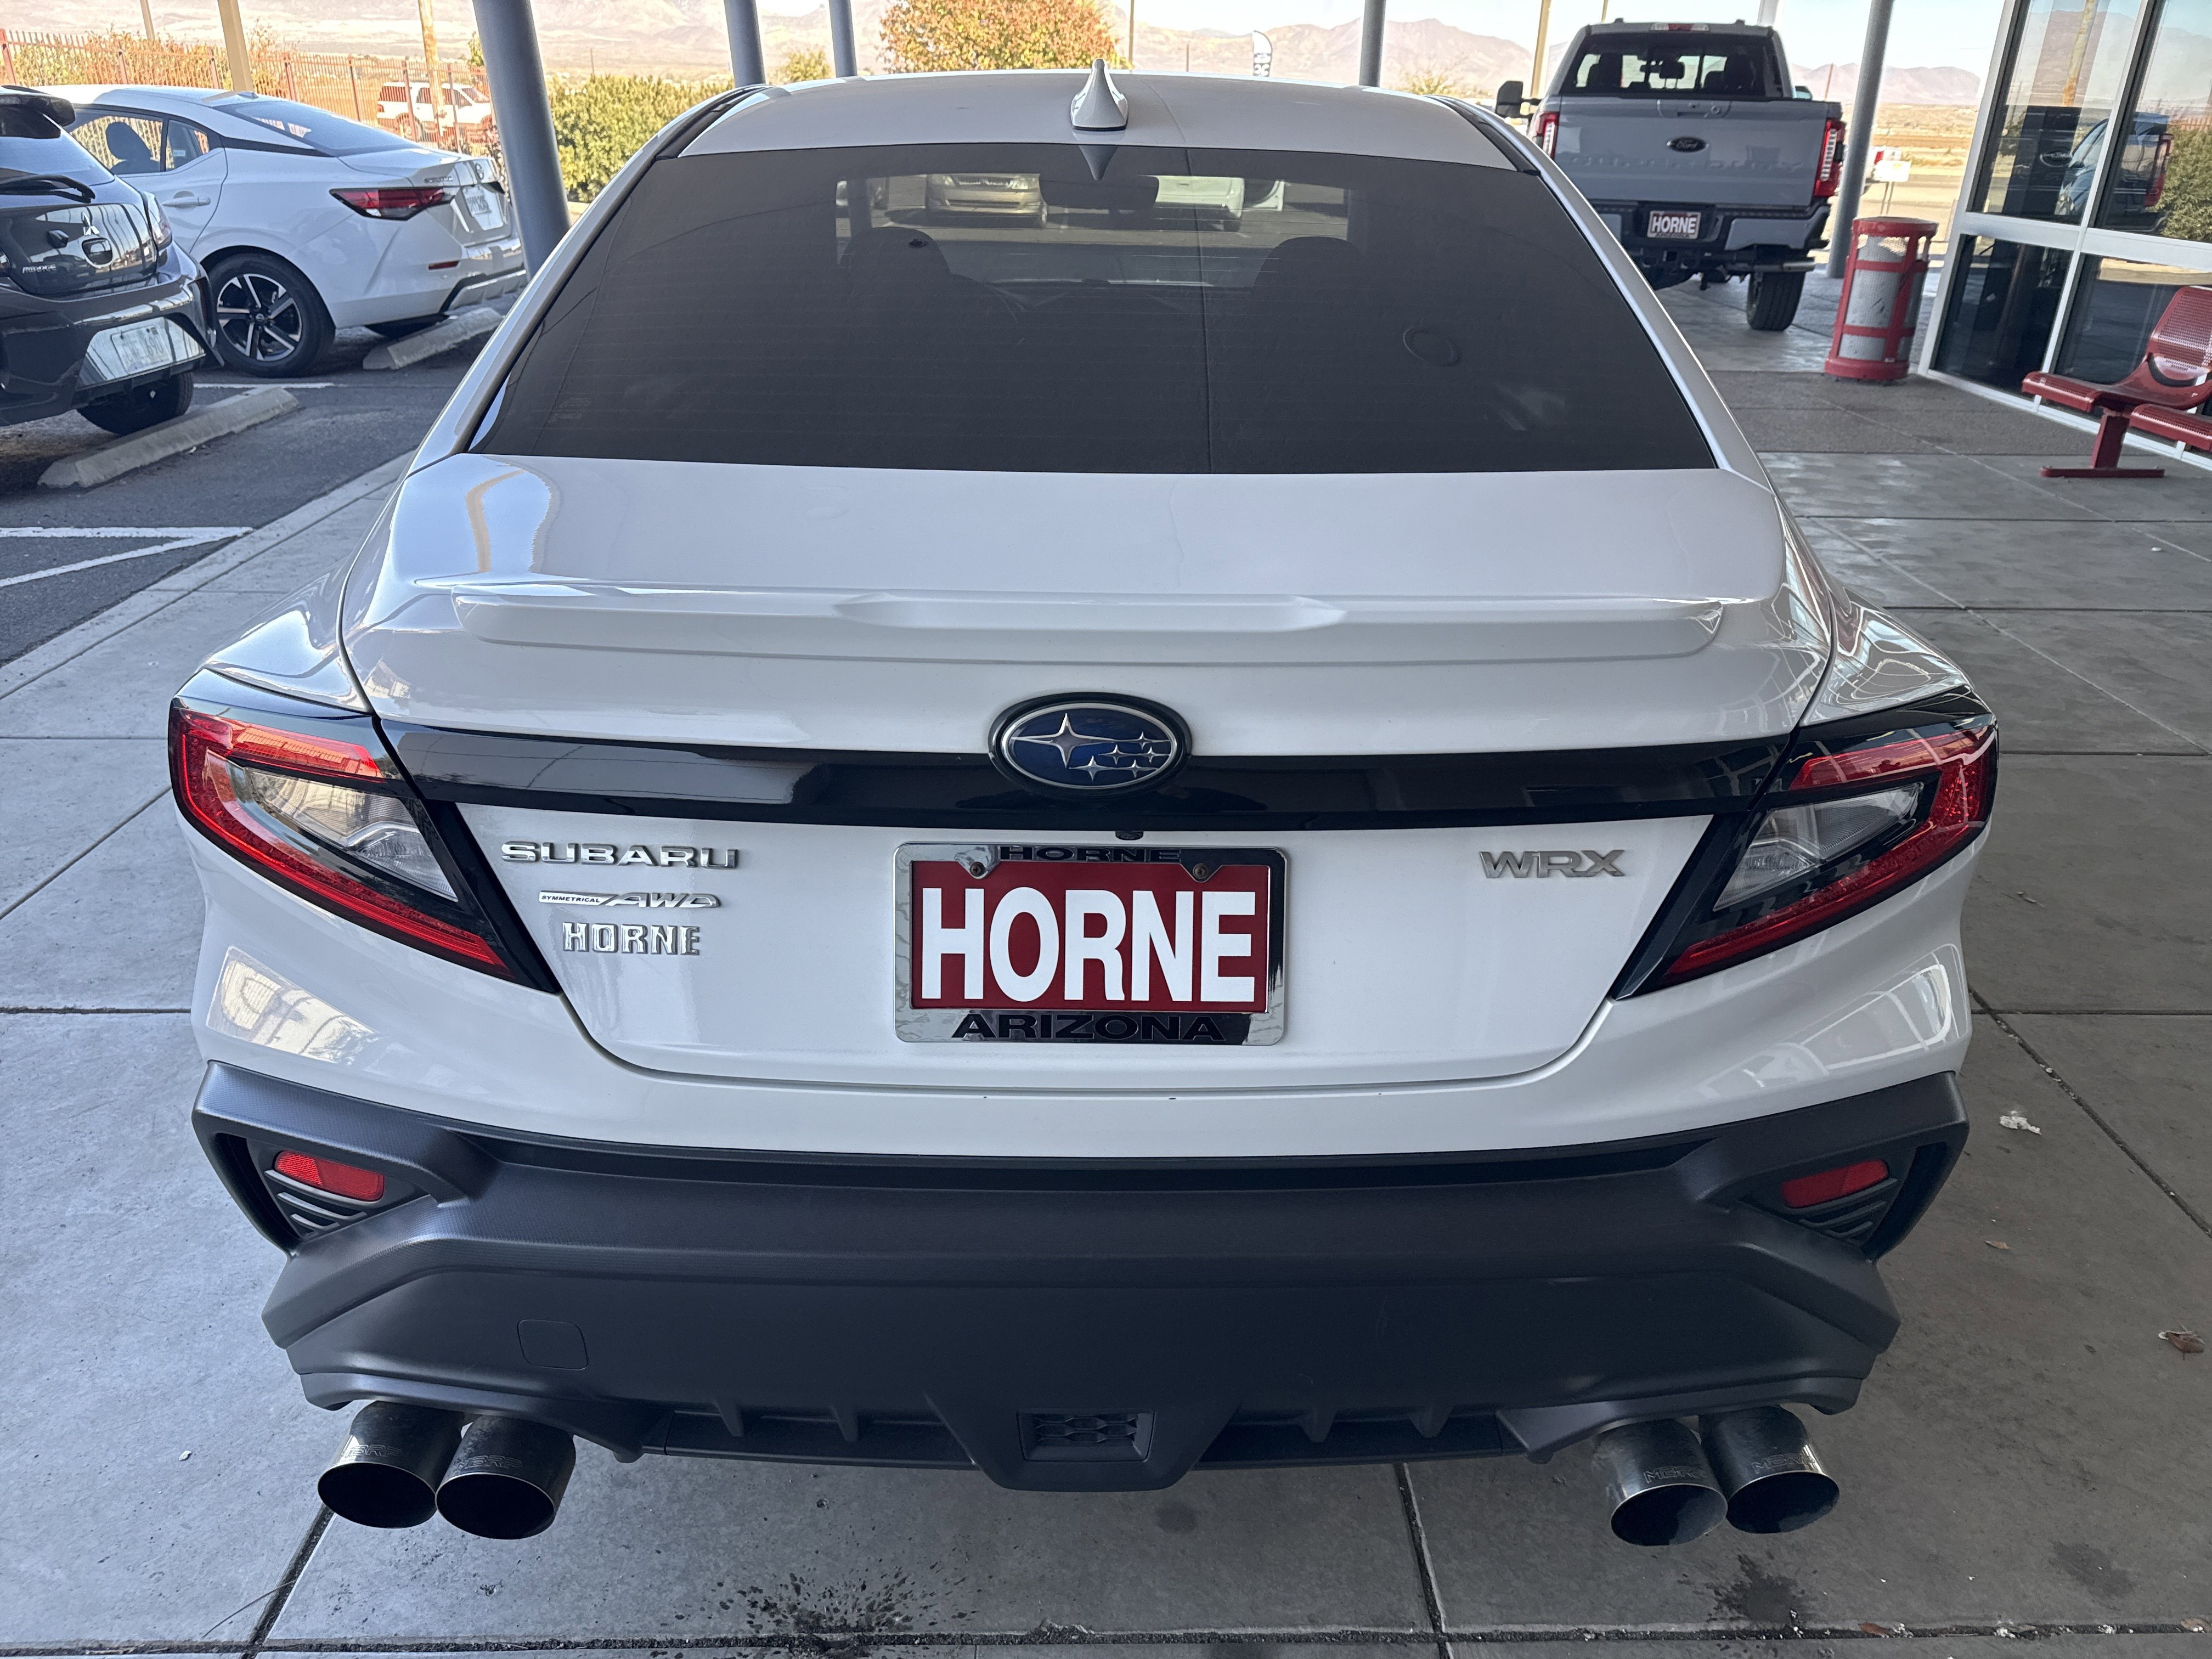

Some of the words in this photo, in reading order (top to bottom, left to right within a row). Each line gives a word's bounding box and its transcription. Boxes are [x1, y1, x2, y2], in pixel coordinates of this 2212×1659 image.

[1652, 216, 1697, 234] HORNE
[501, 841, 738, 870] SUBARU
[1000, 846, 1181, 863] HORNE
[1479, 849, 1625, 879] WRX
[541, 895, 601, 903] SYMMETRICAL
[605, 892, 721, 909] AWD
[562, 922, 701, 956] HORNE
[921, 887, 1256, 1002] HORNE
[951, 1013, 1227, 1041] ARIZONA
